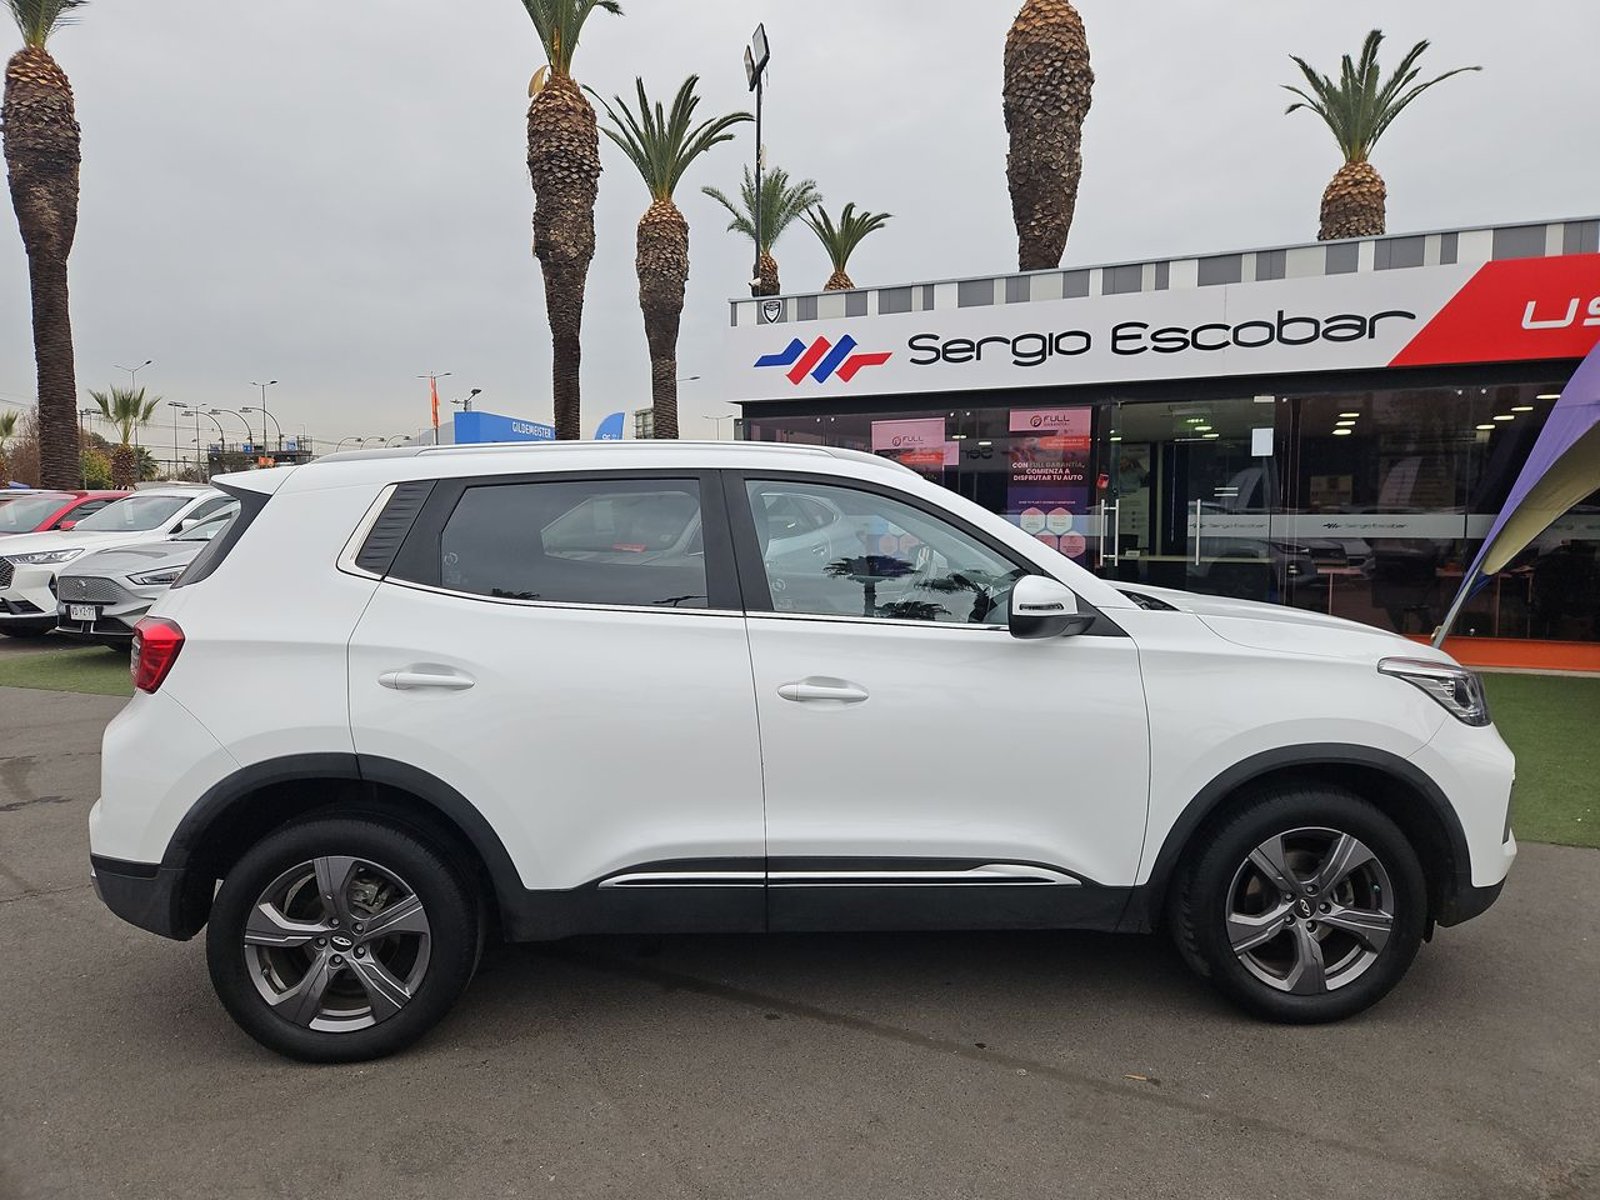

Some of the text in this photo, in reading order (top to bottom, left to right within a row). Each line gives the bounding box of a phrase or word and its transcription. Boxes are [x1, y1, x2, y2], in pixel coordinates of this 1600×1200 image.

[908, 309, 1416, 367] Sergio Escobar
[1043, 414, 1070, 423] FULL
[512, 422, 552, 438] GILDEMEISTER
